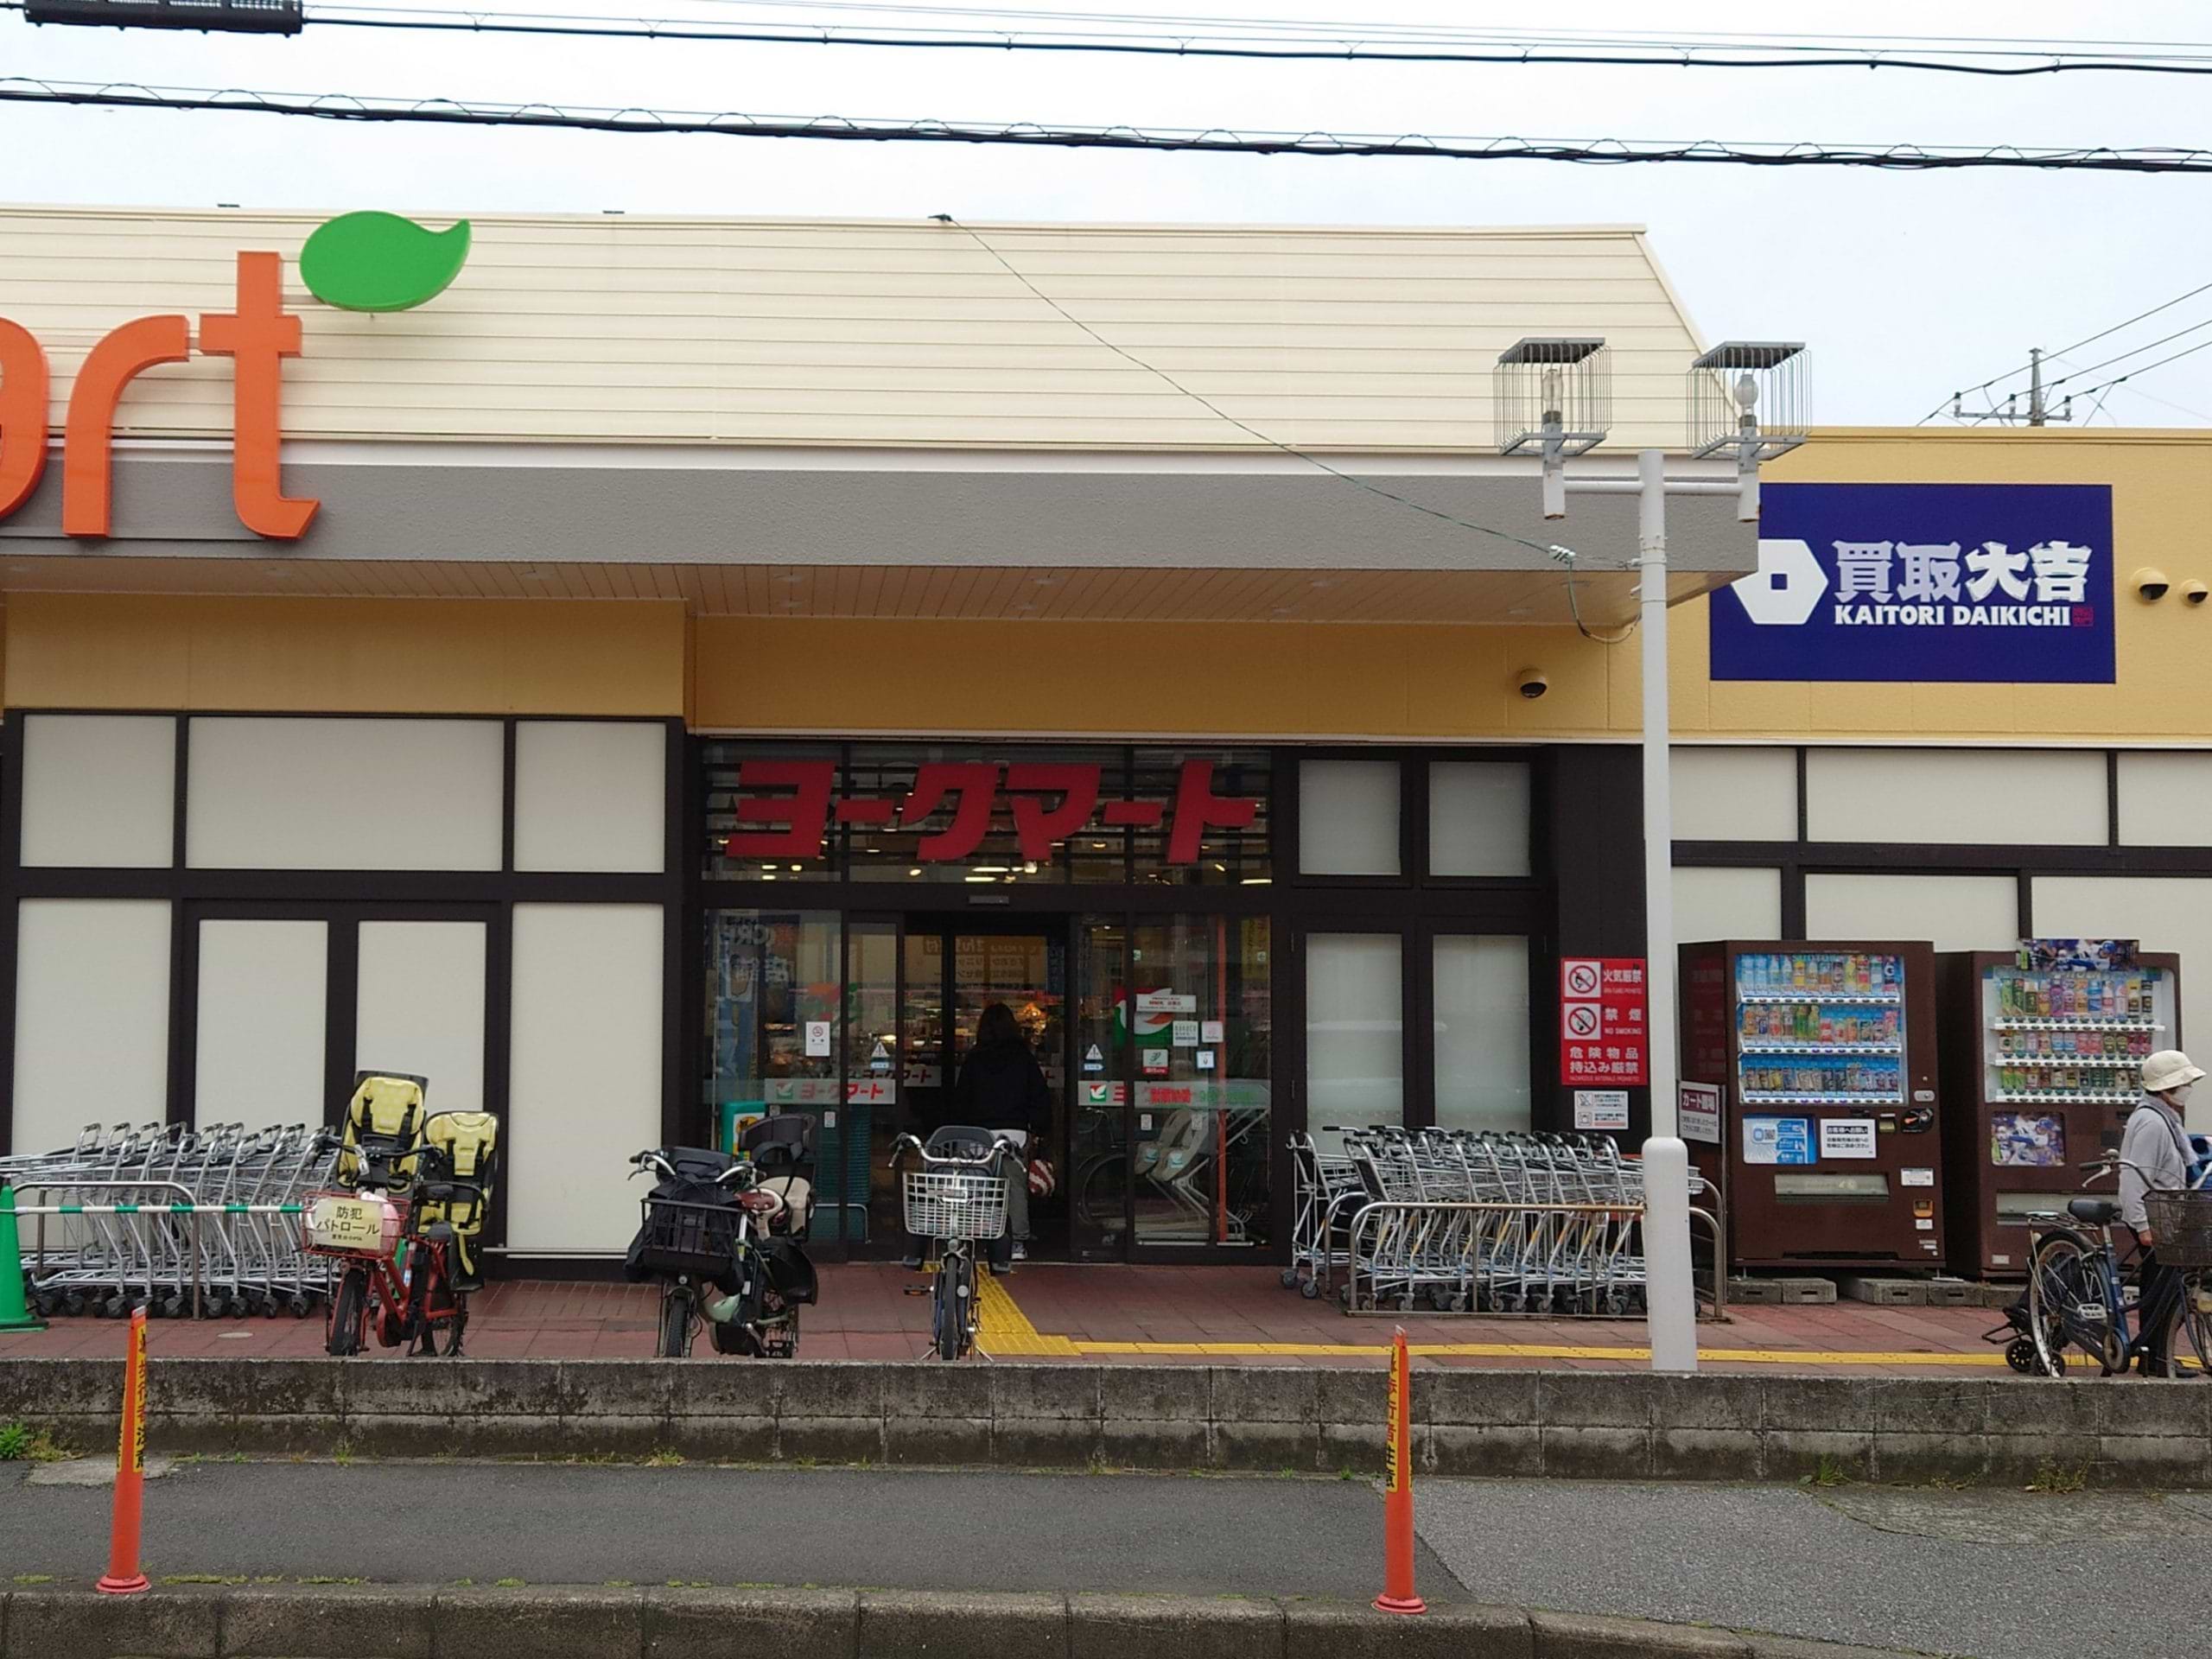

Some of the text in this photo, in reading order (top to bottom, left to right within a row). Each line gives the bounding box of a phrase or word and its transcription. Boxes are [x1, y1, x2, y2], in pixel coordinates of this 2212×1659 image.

[0, 251, 321, 539] rt
[1832, 540, 2094, 603] 買取大吉
[1834, 605, 1944, 626] KAITORI
[1952, 606, 2071, 626] DAIKICHI
[726, 760, 1259, 863] ヨークマート
[1603, 969, 1642, 983] 火気厳禁
[1569, 1061, 1639, 1073] 持込み厳禁
[336, 1205, 363, 1220] 防犯
[316, 1218, 380, 1235] パトロール
